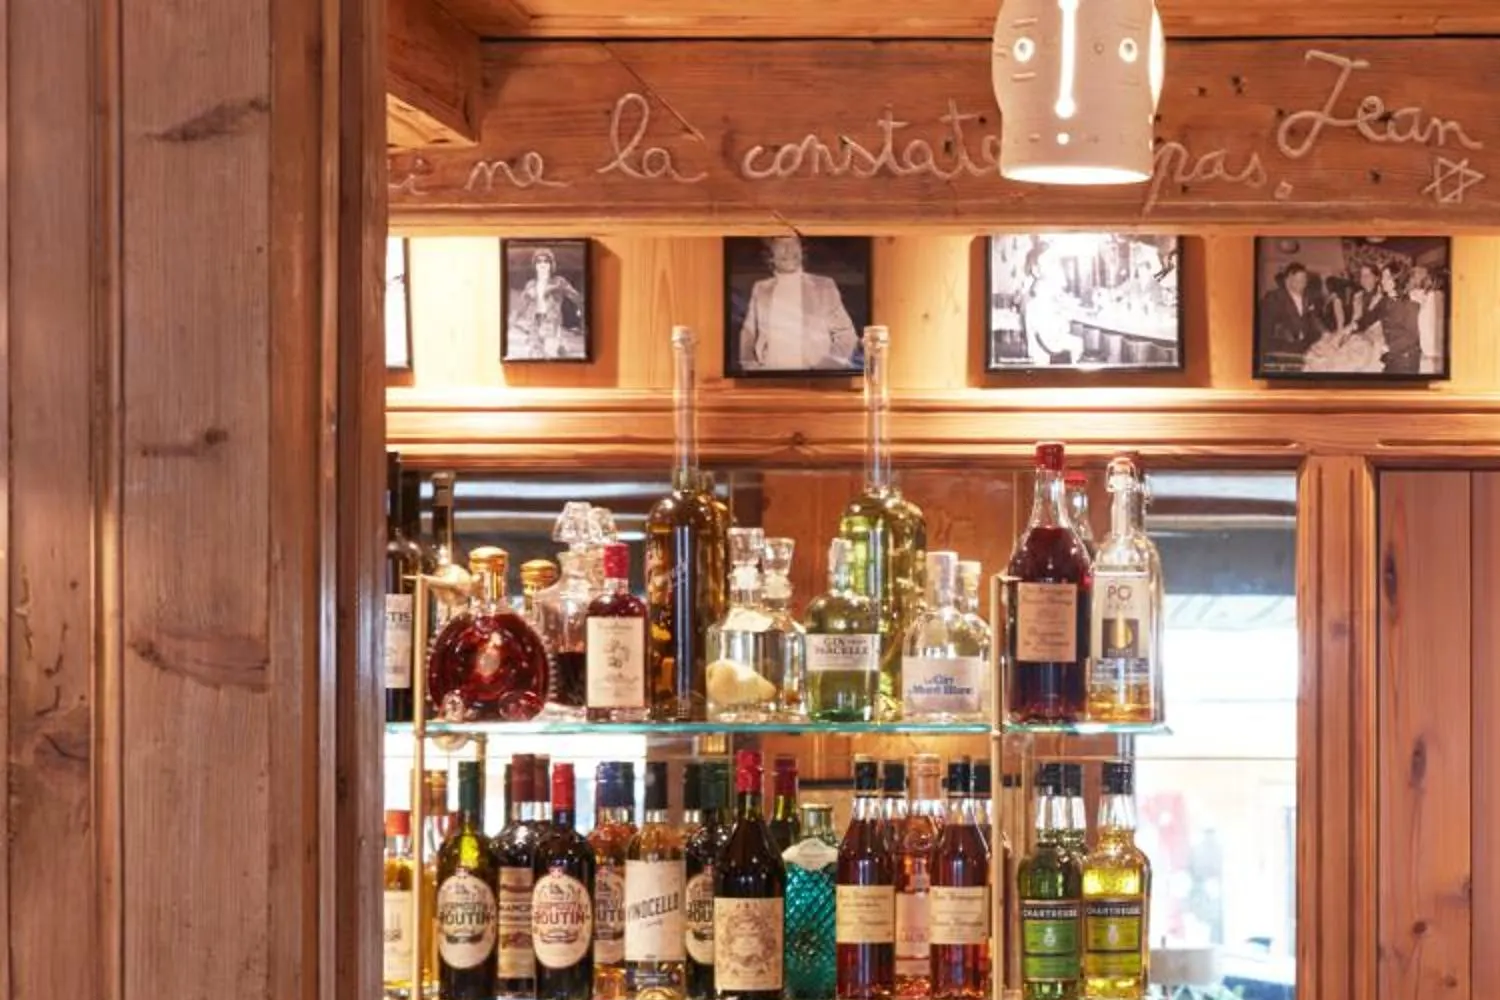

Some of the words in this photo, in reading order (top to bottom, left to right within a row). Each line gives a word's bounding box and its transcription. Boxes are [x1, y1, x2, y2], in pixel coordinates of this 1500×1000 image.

[463, 151, 572, 193] ne
[597, 93, 708, 183] la
[1278, 50, 1484, 159] Jean
